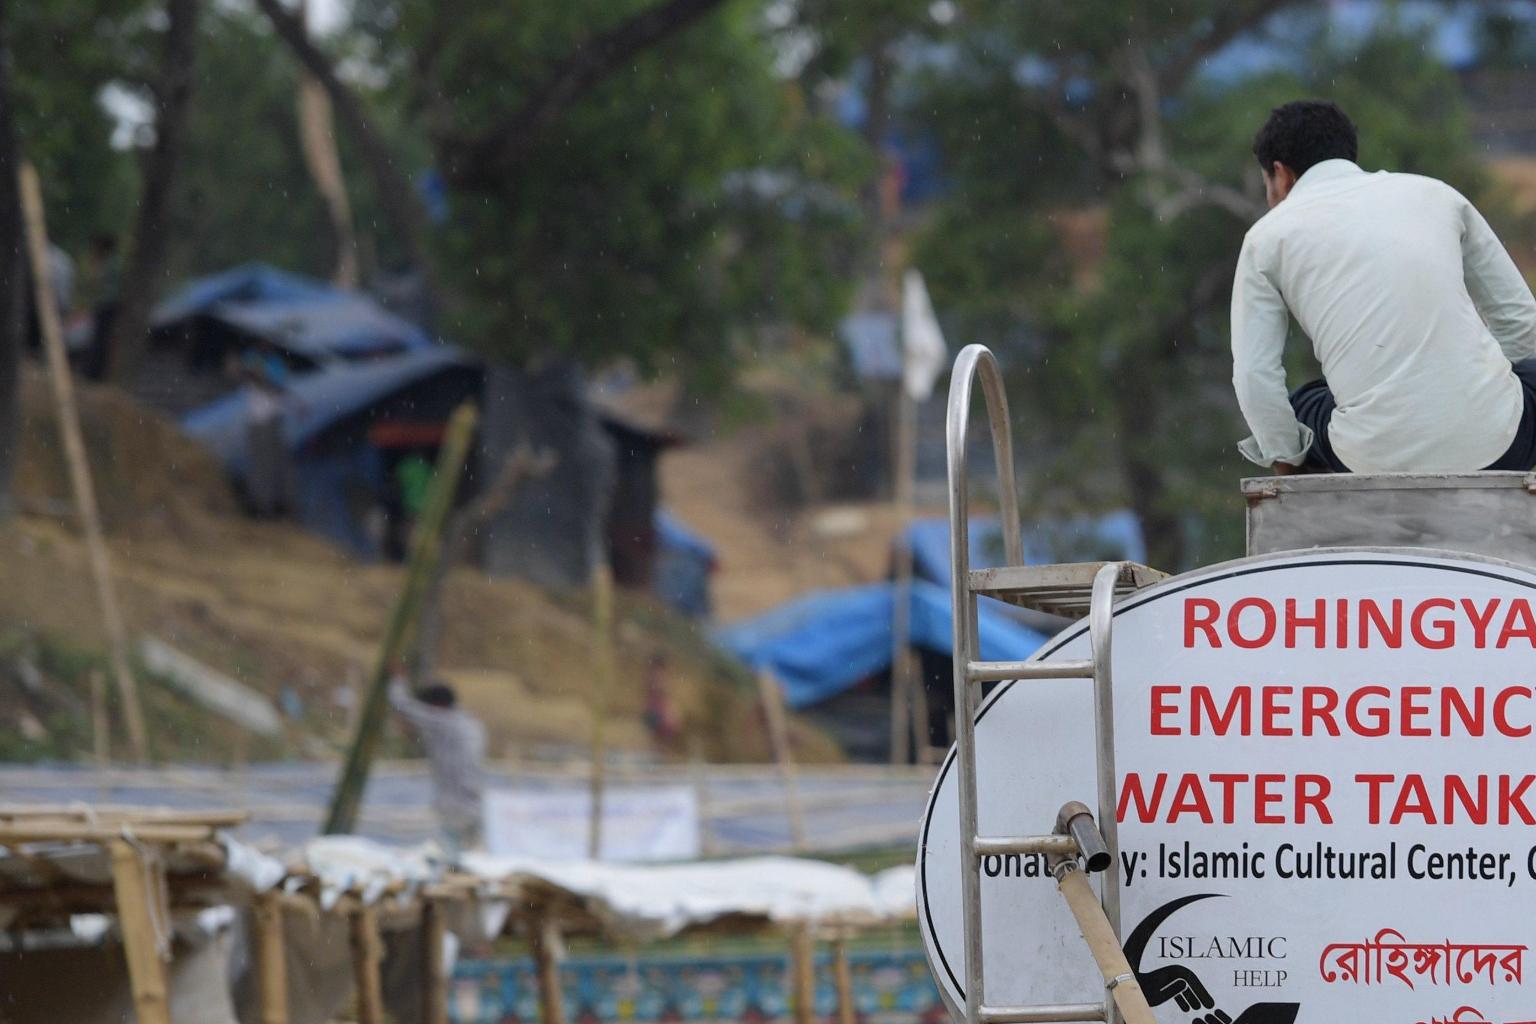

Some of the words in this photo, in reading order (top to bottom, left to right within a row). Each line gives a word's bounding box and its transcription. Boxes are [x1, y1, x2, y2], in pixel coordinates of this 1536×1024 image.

[1119, 851, 1147, 887] y:
[1159, 840, 1265, 879] Islamic
[1276, 840, 1396, 880] Cultural
[1408, 842, 1517, 890] Center,
[1157, 935, 1288, 959] ISLAMIC
[1319, 927, 1528, 991] রোহিঙ্গাদের
[1232, 969, 1288, 988] HELP
